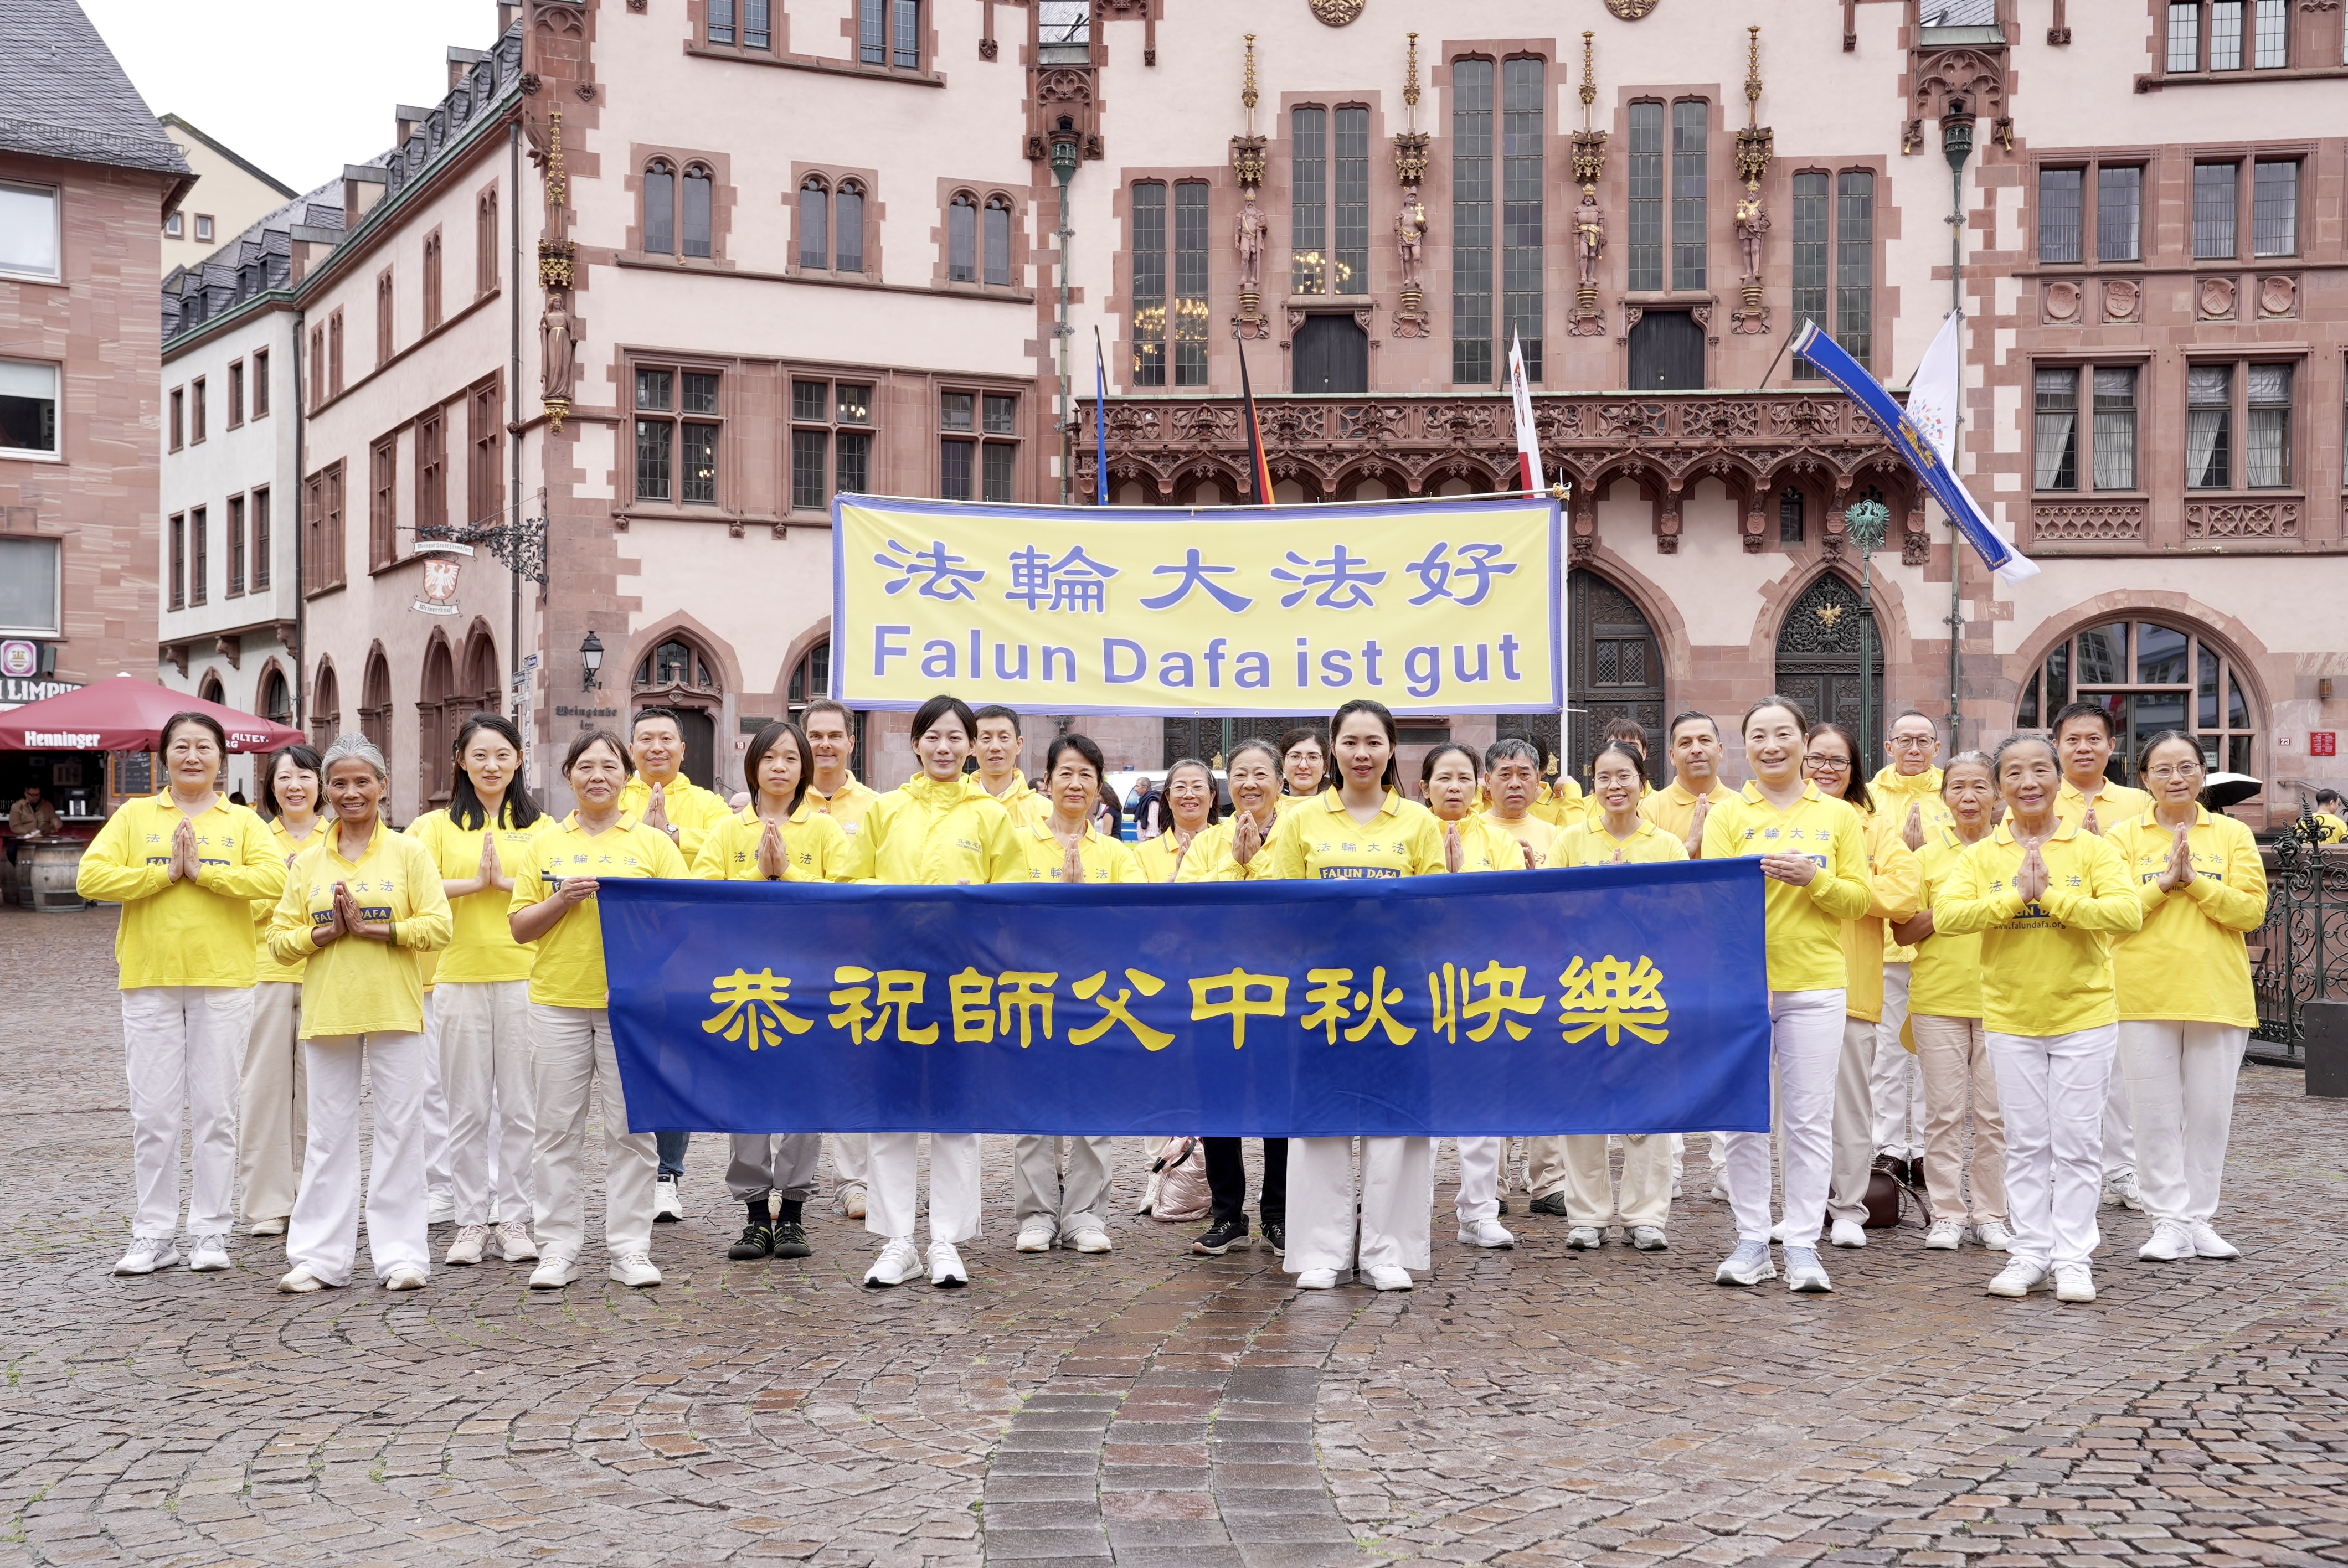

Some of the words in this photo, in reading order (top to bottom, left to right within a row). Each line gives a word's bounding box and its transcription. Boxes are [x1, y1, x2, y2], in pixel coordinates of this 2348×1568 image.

[449, 543, 471, 553] Frankfurt
[874, 539, 1518, 613] 法輪大法好
[874, 625, 1077, 683] Falun
[1103, 637, 1270, 689] Dafa
[1297, 637, 1383, 688] ist
[1404, 633, 1522, 698] gut
[7, 679, 82, 701] LIMP
[25, 731, 101, 749] Henninger
[146, 833, 235, 848] 法大法
[1742, 828, 1830, 841] 法輪大法
[1317, 842, 1404, 854] 法輪大法
[550, 854, 638, 868] 法輪大法
[734, 849, 812, 864] 法法
[1029, 867, 1108, 879] 法輪法
[1322, 869, 1362, 879] FALUN
[1367, 869, 1398, 879] DAFA
[1989, 875, 2081, 893] 法法
[315, 912, 333, 922] FAL
[702, 954, 1669, 1051] 恭祝師父中秋快樂
